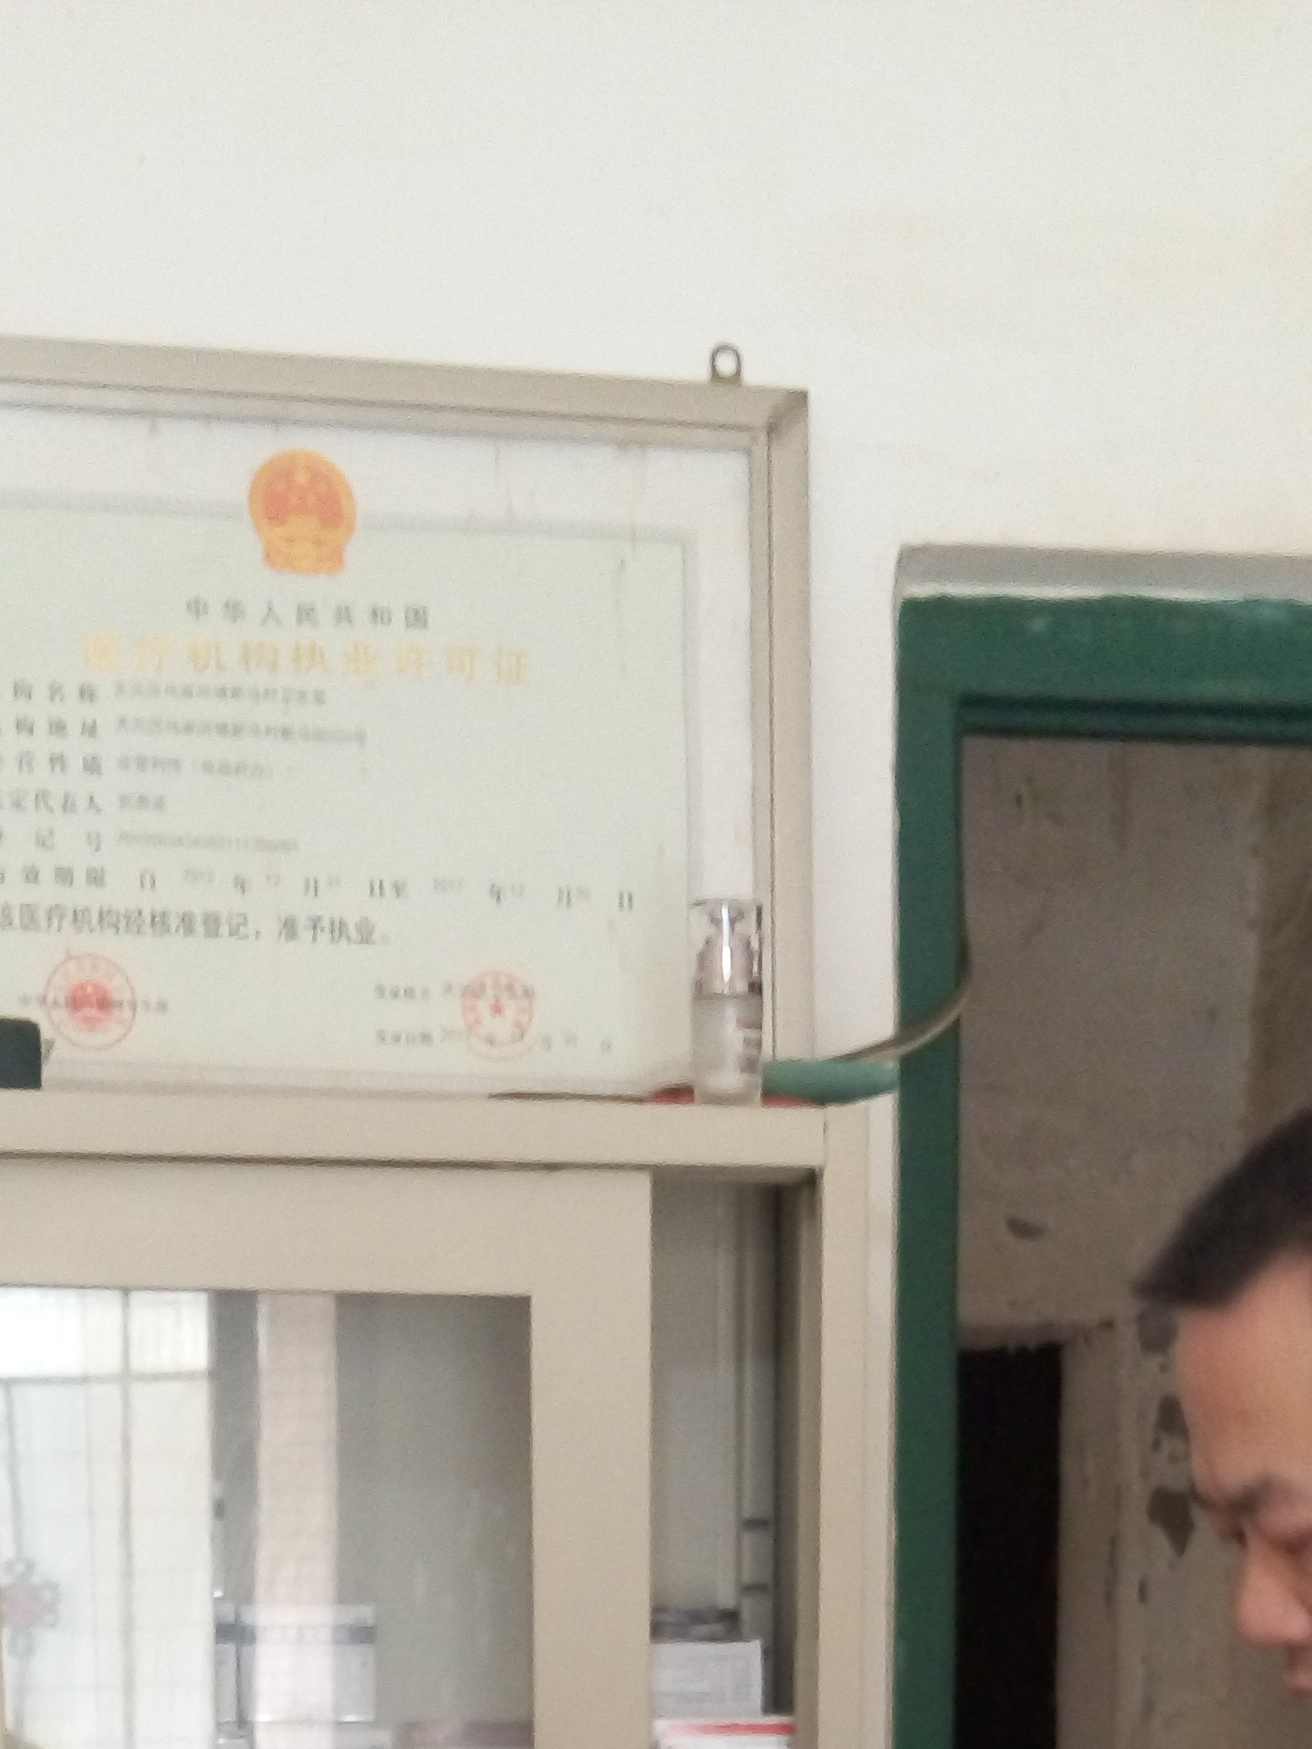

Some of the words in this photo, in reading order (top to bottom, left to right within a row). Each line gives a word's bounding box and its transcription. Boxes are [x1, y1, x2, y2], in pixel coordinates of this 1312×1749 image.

[186, 596, 430, 631] 中华人民共和国
